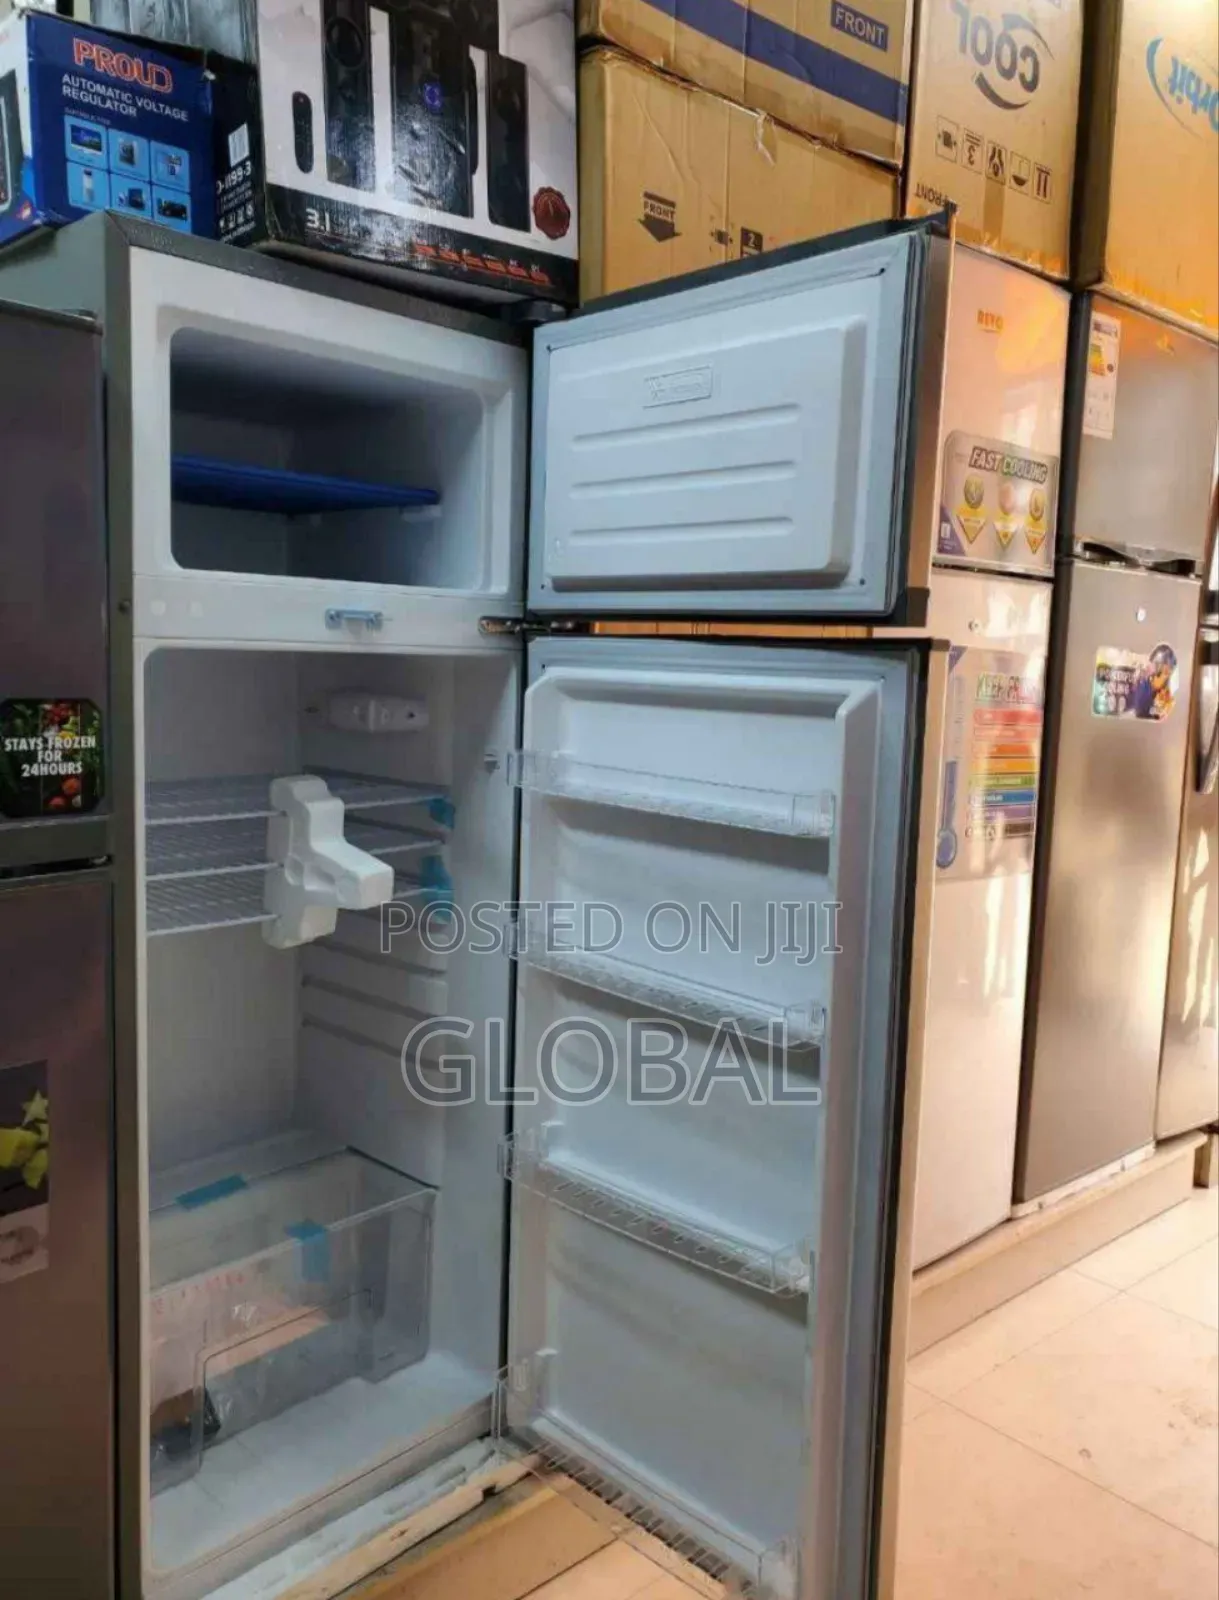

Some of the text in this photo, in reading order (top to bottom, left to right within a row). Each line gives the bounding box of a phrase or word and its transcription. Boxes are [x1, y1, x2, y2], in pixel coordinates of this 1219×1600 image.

[834, 6, 886, 47] FRONT
[73, 37, 173, 94] PROUD
[62, 73, 133, 105] AUTOMATIC
[136, 95, 189, 122] VOLTAGE
[62, 85, 137, 117] REGULATOR
[967, 145, 976, 166] 3
[643, 200, 676, 221] FRONT
[748, 232, 756, 247] 2
[970, 448, 1048, 483] FAST COOLING
[4, 736, 96, 752] STAYS FROZEN
[38, 750, 62, 763] FOR
[21, 762, 83, 777] 24HOURS
